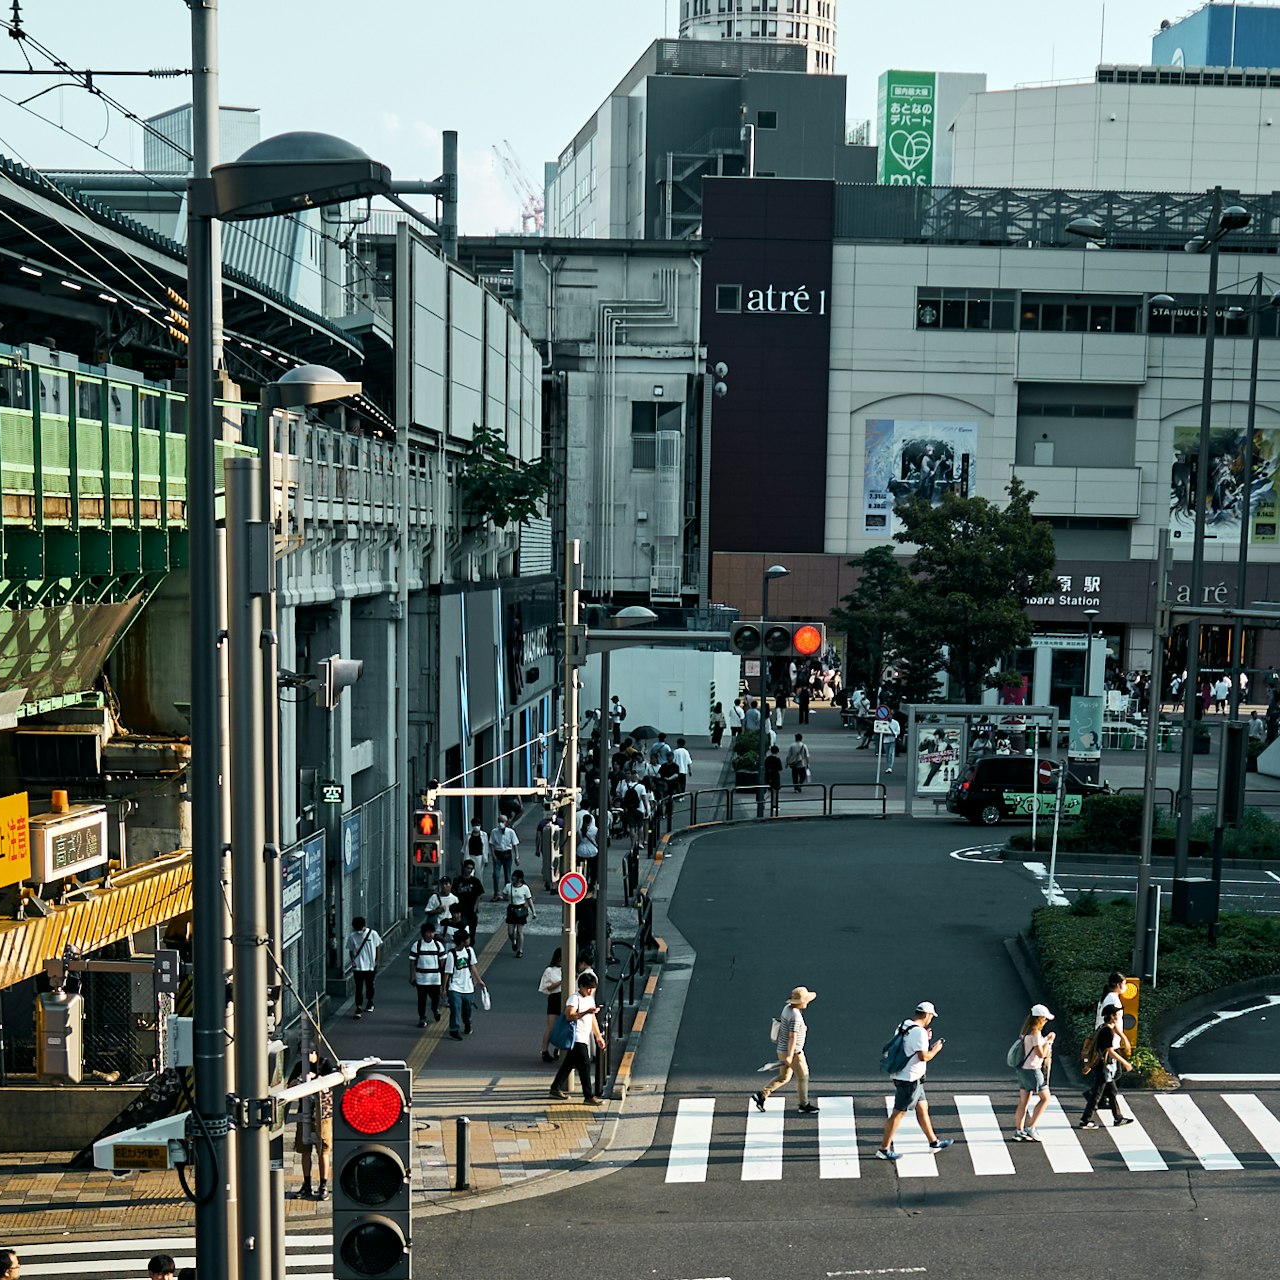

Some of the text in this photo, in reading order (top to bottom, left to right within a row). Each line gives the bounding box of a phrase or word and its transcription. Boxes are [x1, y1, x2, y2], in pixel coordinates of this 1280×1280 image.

[890, 102, 932, 115] おとなの
[890, 114, 932, 127] デパート
[746, 283, 810, 312] atré
[1059, 595, 1100, 606] Station
[323, 785, 342, 803] 空
[7, 815, 27, 862] 注意
